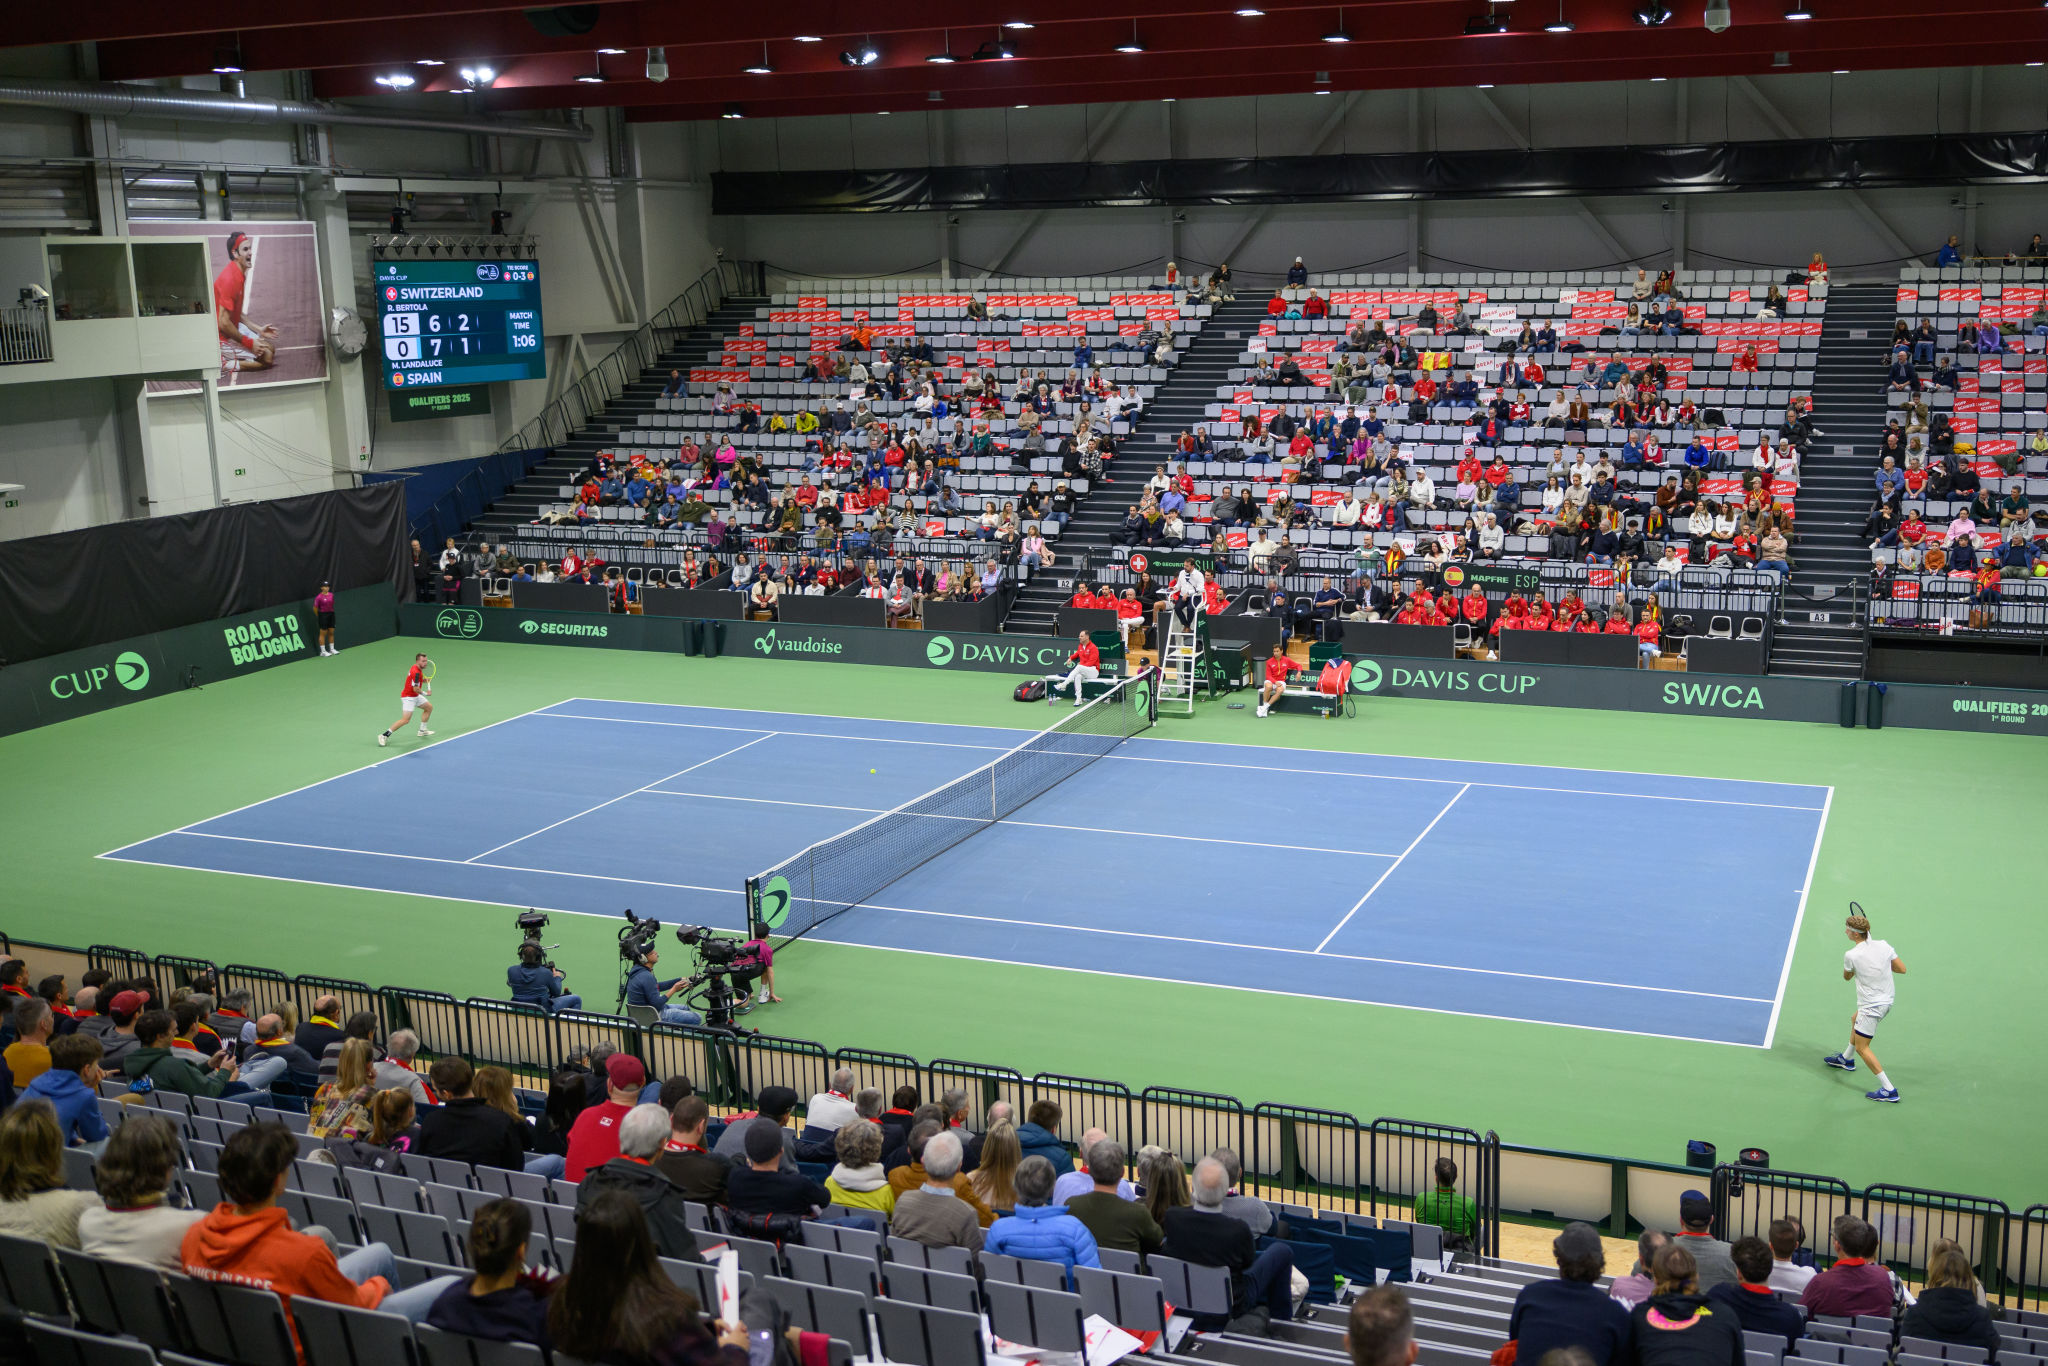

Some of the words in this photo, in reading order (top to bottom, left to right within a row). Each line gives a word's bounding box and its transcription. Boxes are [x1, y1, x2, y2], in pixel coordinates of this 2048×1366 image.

[513, 272, 526, 280] 0-3
[401, 287, 483, 299] SWITZERLAND
[392, 317, 410, 333] 15
[429, 315, 441, 332] 6
[458, 314, 469, 331] 2
[398, 341, 408, 357] 0
[431, 339, 442, 356] 7
[461, 338, 468, 354] 1
[513, 335, 535, 347] 1:06
[1466, 343, 1482, 351] BREAK
[401, 360, 442, 368] LANDALUCE
[1476, 360, 1493, 368] BREAK
[407, 372, 442, 384] SPAIN
[409, 395, 450, 407] QUALIFIERS
[452, 394, 470, 403] 2025
[1470, 574, 1509, 583] MAPFRE
[1515, 574, 1539, 588] ESP
[224, 620, 272, 647] ROAD
[274, 614, 298, 634] TO
[540, 622, 608, 638] SECURITAS
[230, 632, 305, 666] BOLOGNA
[777, 636, 842, 654] vaudoise
[962, 644, 1029, 664] DAVIS
[1392, 668, 1469, 691] DAVIS
[1953, 700, 2028, 714] QUALIFIERS
